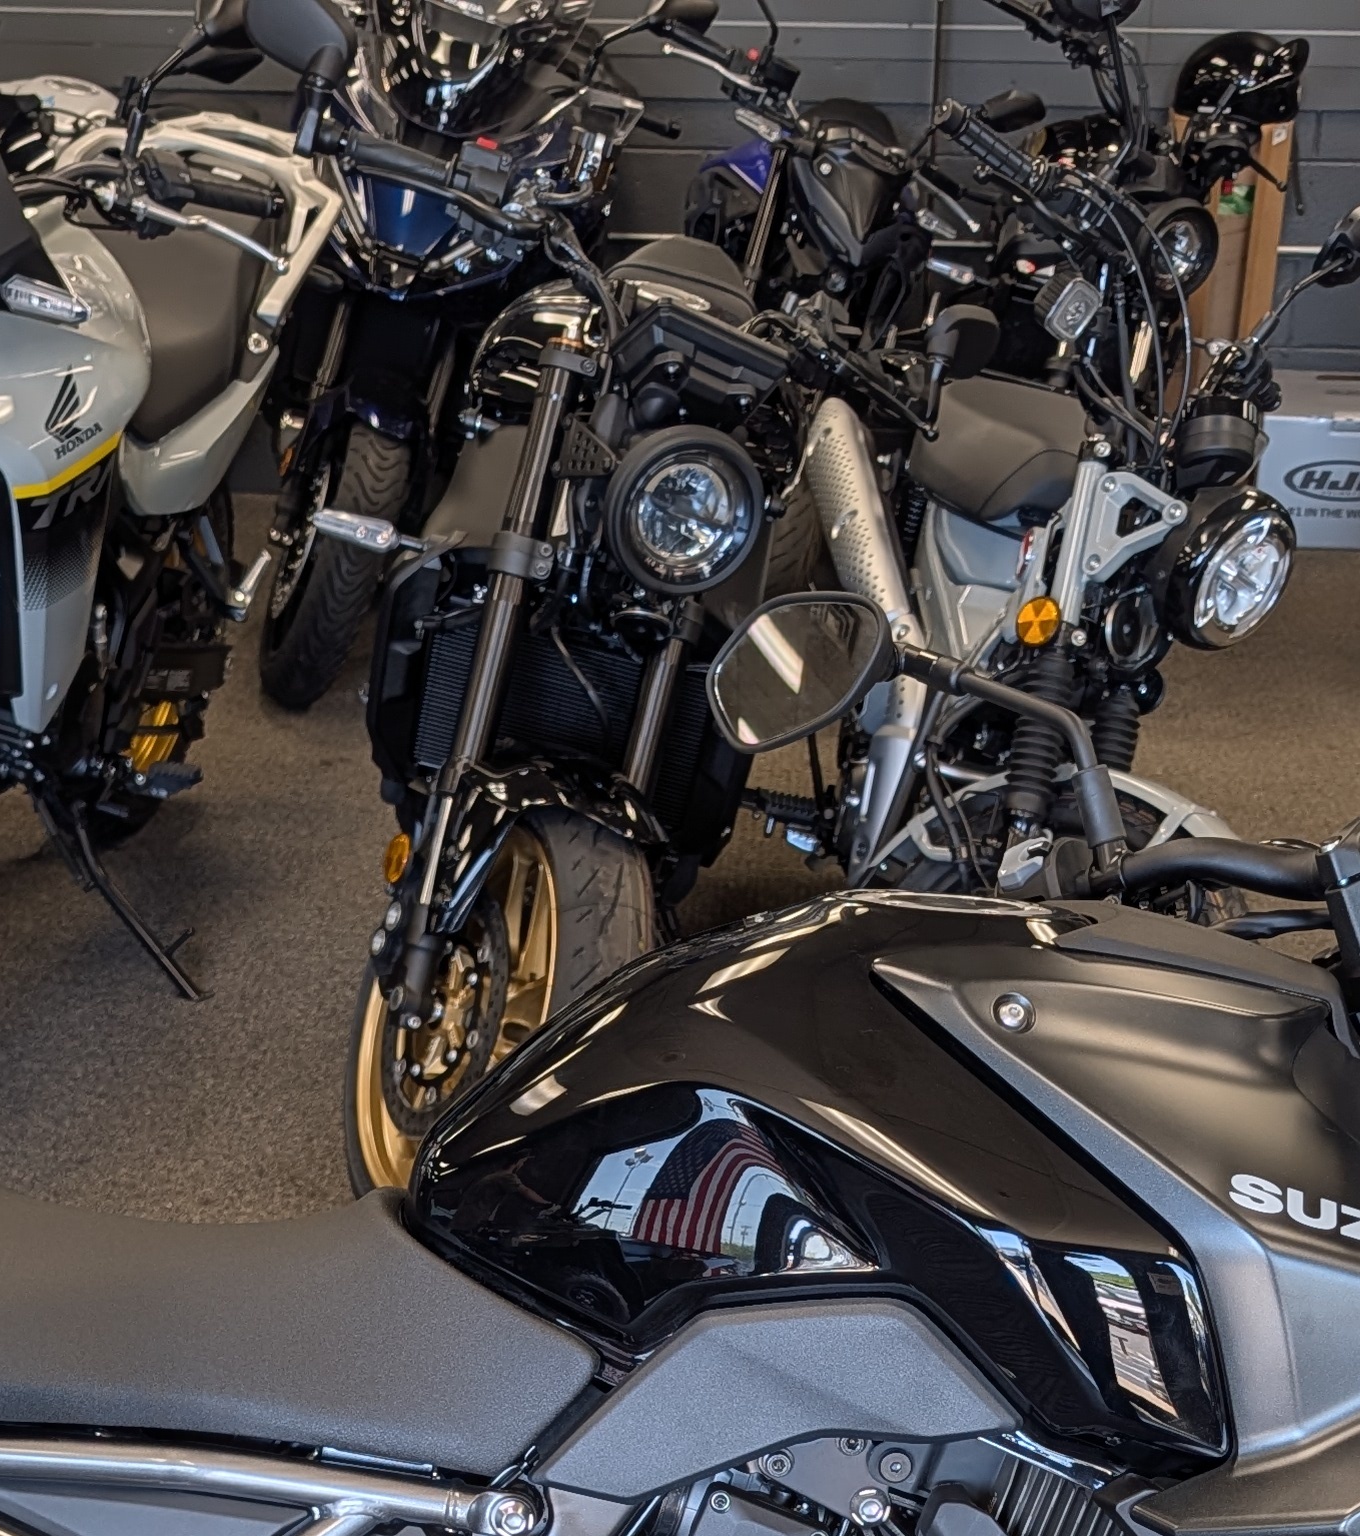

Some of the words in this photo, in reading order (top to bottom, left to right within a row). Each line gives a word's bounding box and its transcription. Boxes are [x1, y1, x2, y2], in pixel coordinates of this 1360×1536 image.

[54, 422, 103, 460] HONDA
[1304, 508, 1317, 518] IN
[1319, 508, 1343, 519] THE
